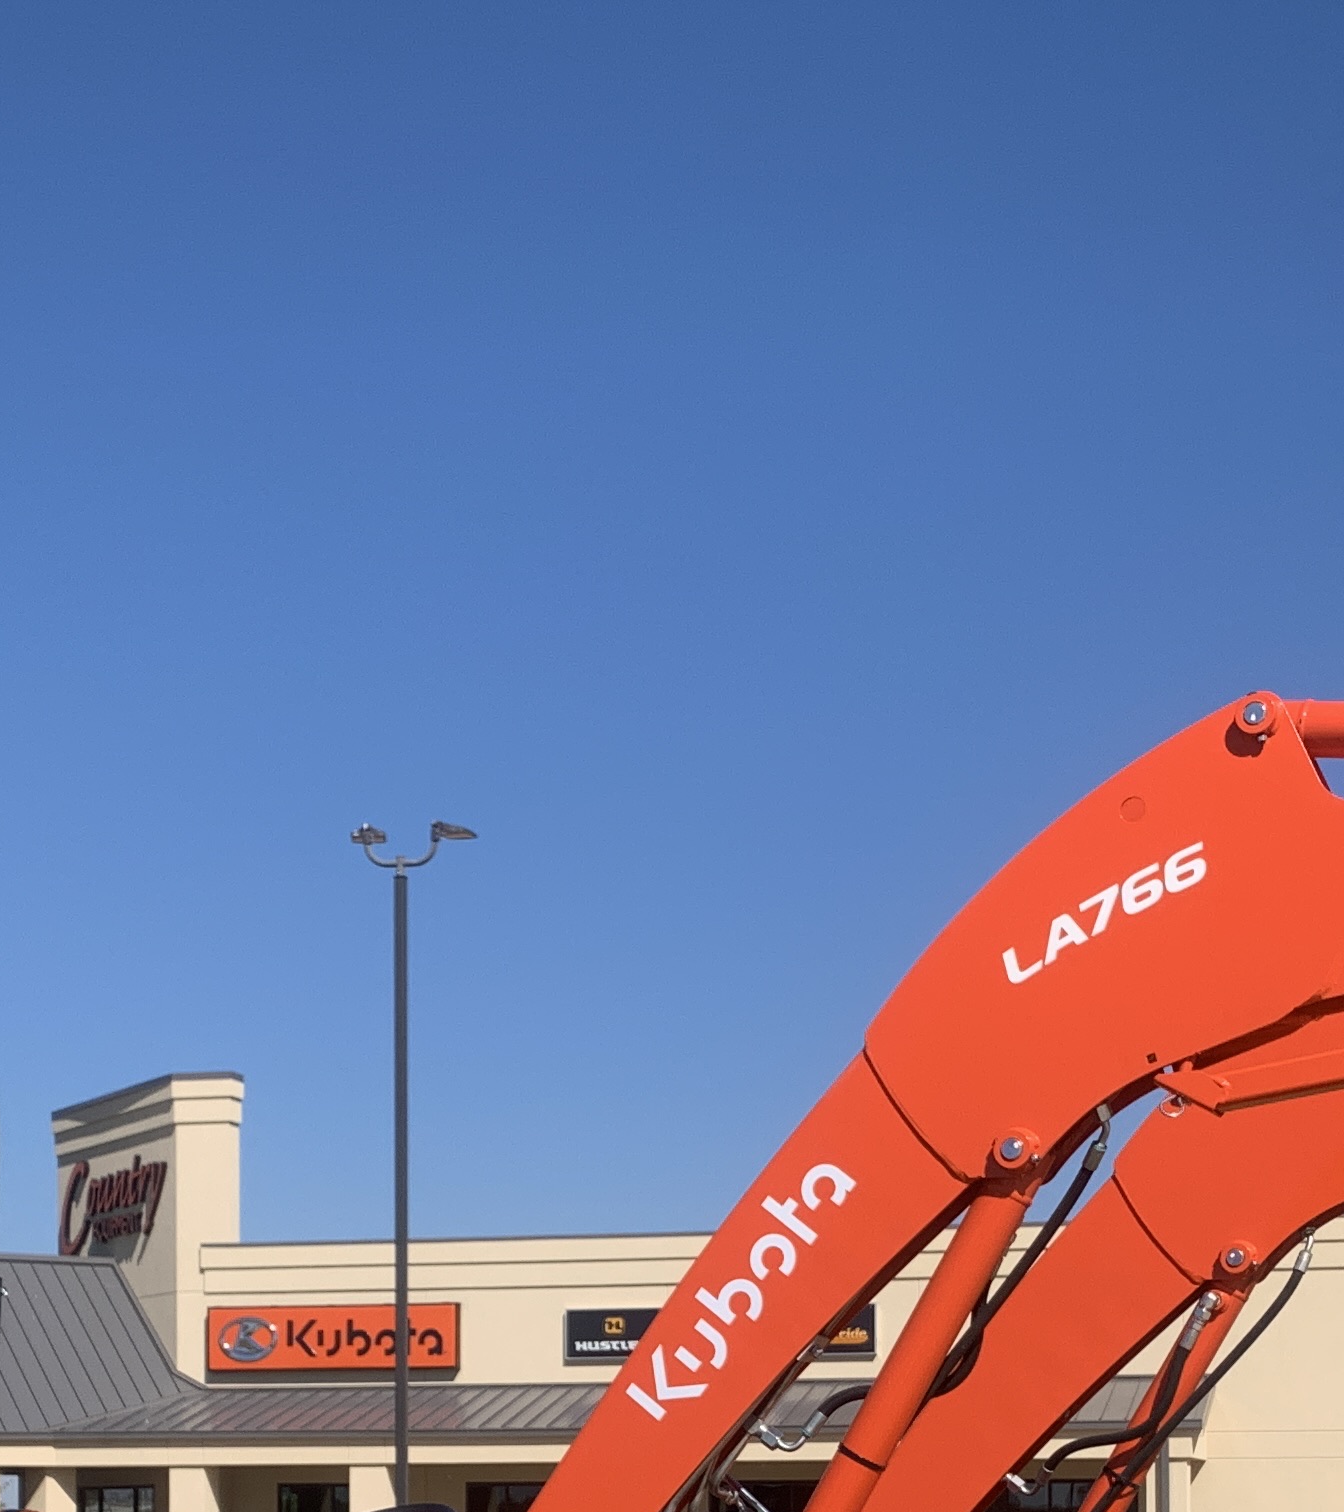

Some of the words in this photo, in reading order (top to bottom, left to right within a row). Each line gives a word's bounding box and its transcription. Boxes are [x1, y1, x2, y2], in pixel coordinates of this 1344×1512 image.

[1002, 841, 1206, 985] LA766
[286, 1319, 444, 1357] Kubota
[625, 1163, 857, 1422] Kubota
[574, 1340, 640, 1351] HUSTLE
